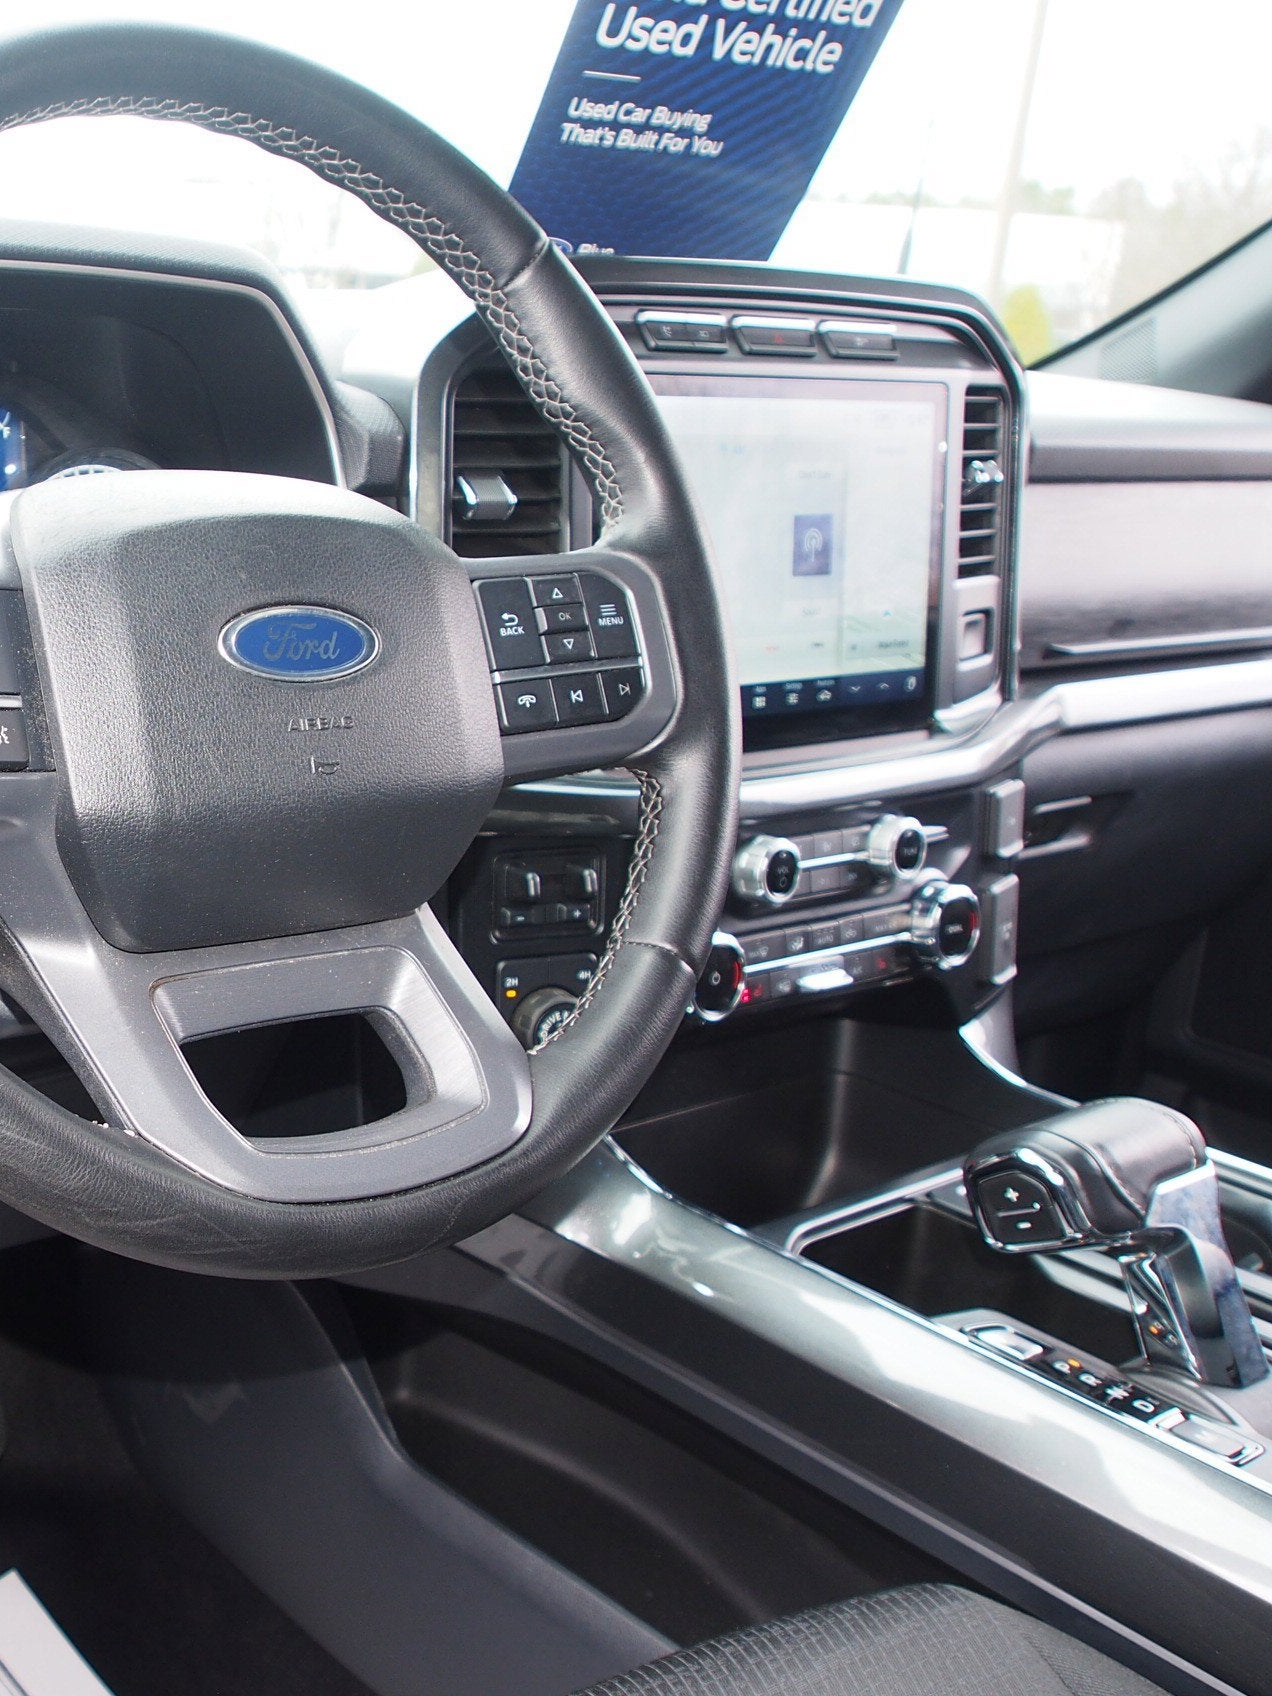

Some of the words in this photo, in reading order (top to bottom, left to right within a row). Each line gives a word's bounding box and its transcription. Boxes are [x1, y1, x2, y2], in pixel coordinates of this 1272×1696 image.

[596, 3, 709, 57] Used
[710, 18, 843, 74] Vehicle
[568, 97, 620, 121] Used
[617, 102, 652, 125] Car
[650, 106, 712, 134] Buying
[561, 123, 616, 147] That's
[615, 129, 659, 150] Built
[658, 133, 691, 153] For
[689, 136, 724, 157] You
[558, 612, 571, 620] OK
[598, 616, 624, 626] MENU
[499, 625, 525, 636] BACK
[262, 623, 341, 662] Ford
[287, 715, 353, 732] AIRBAG
[505, 978, 519, 987] 2H
